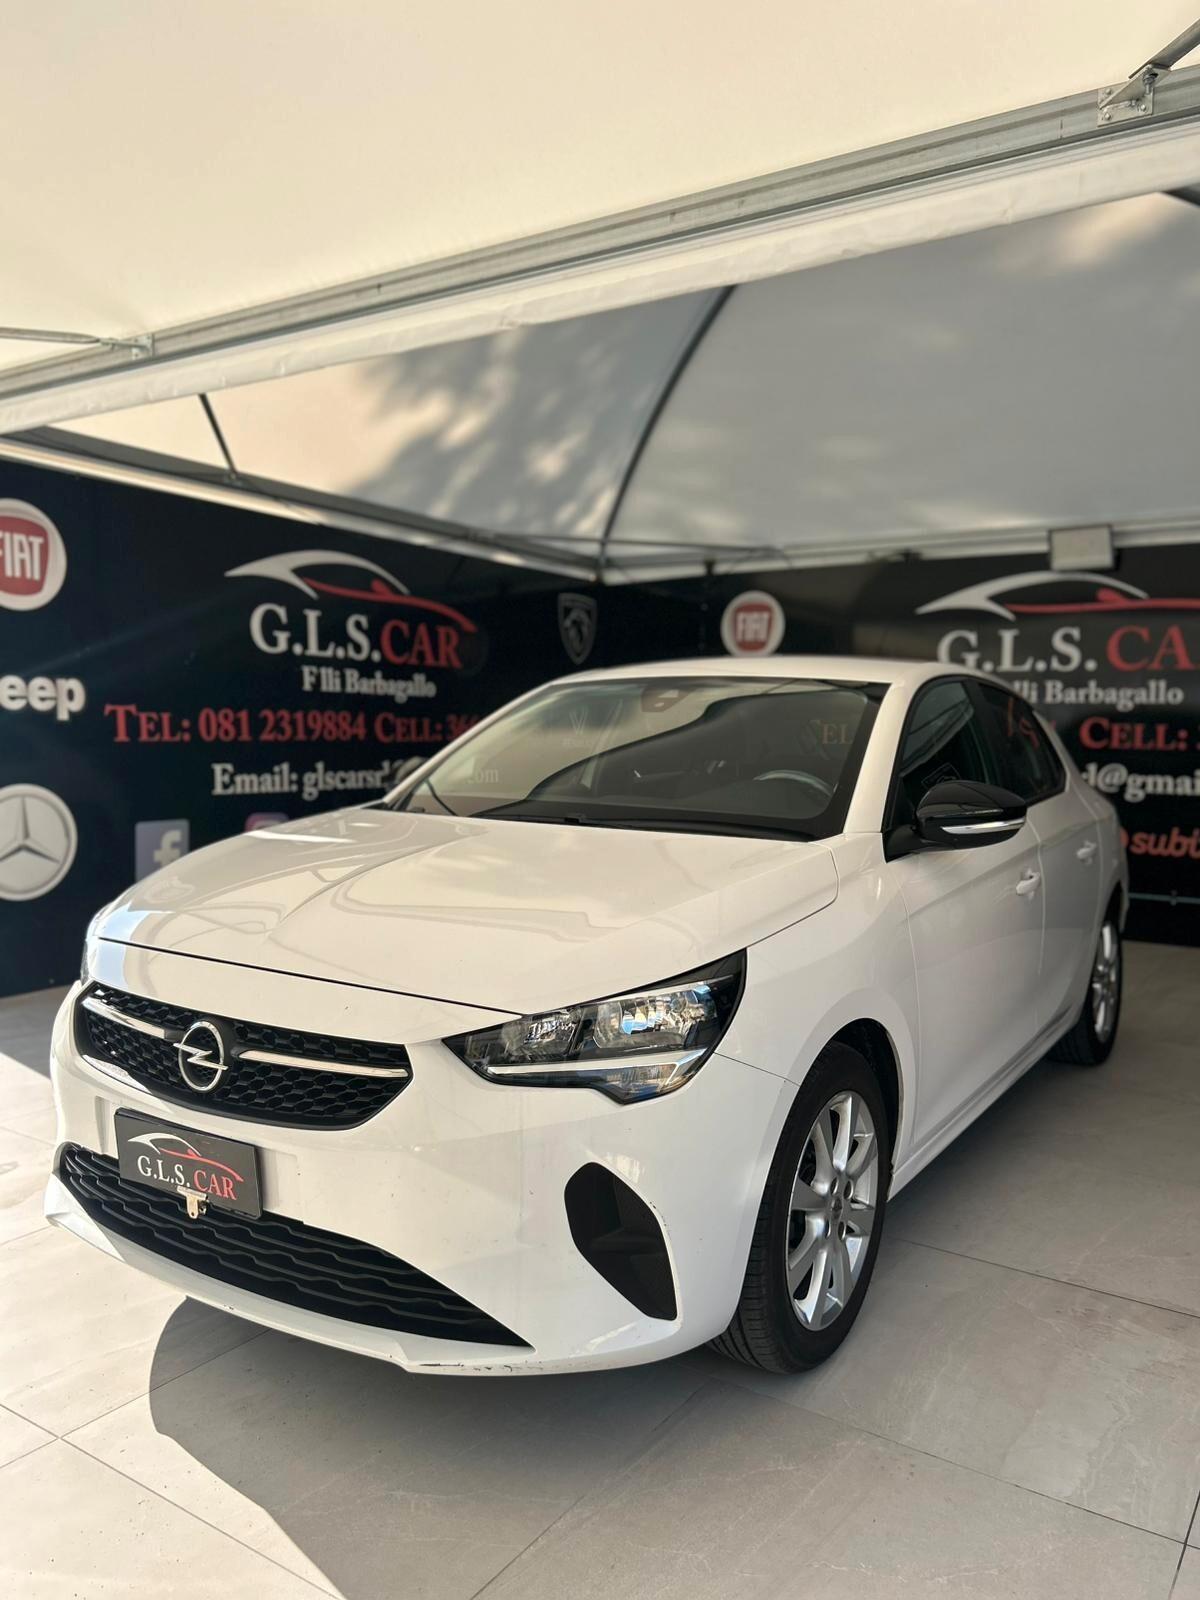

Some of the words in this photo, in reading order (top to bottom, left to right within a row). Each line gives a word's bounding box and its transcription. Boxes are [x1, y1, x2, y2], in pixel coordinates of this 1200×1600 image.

[1106, 622, 1200, 671] CA
[0, 674, 86, 721] eep
[343, 667, 437, 704] Barbagallo
[1044, 678, 1184, 713] Barbagallo
[198, 707, 252, 743] 081
[258, 708, 367, 743] 2319884
[211, 762, 299, 796] Email:
